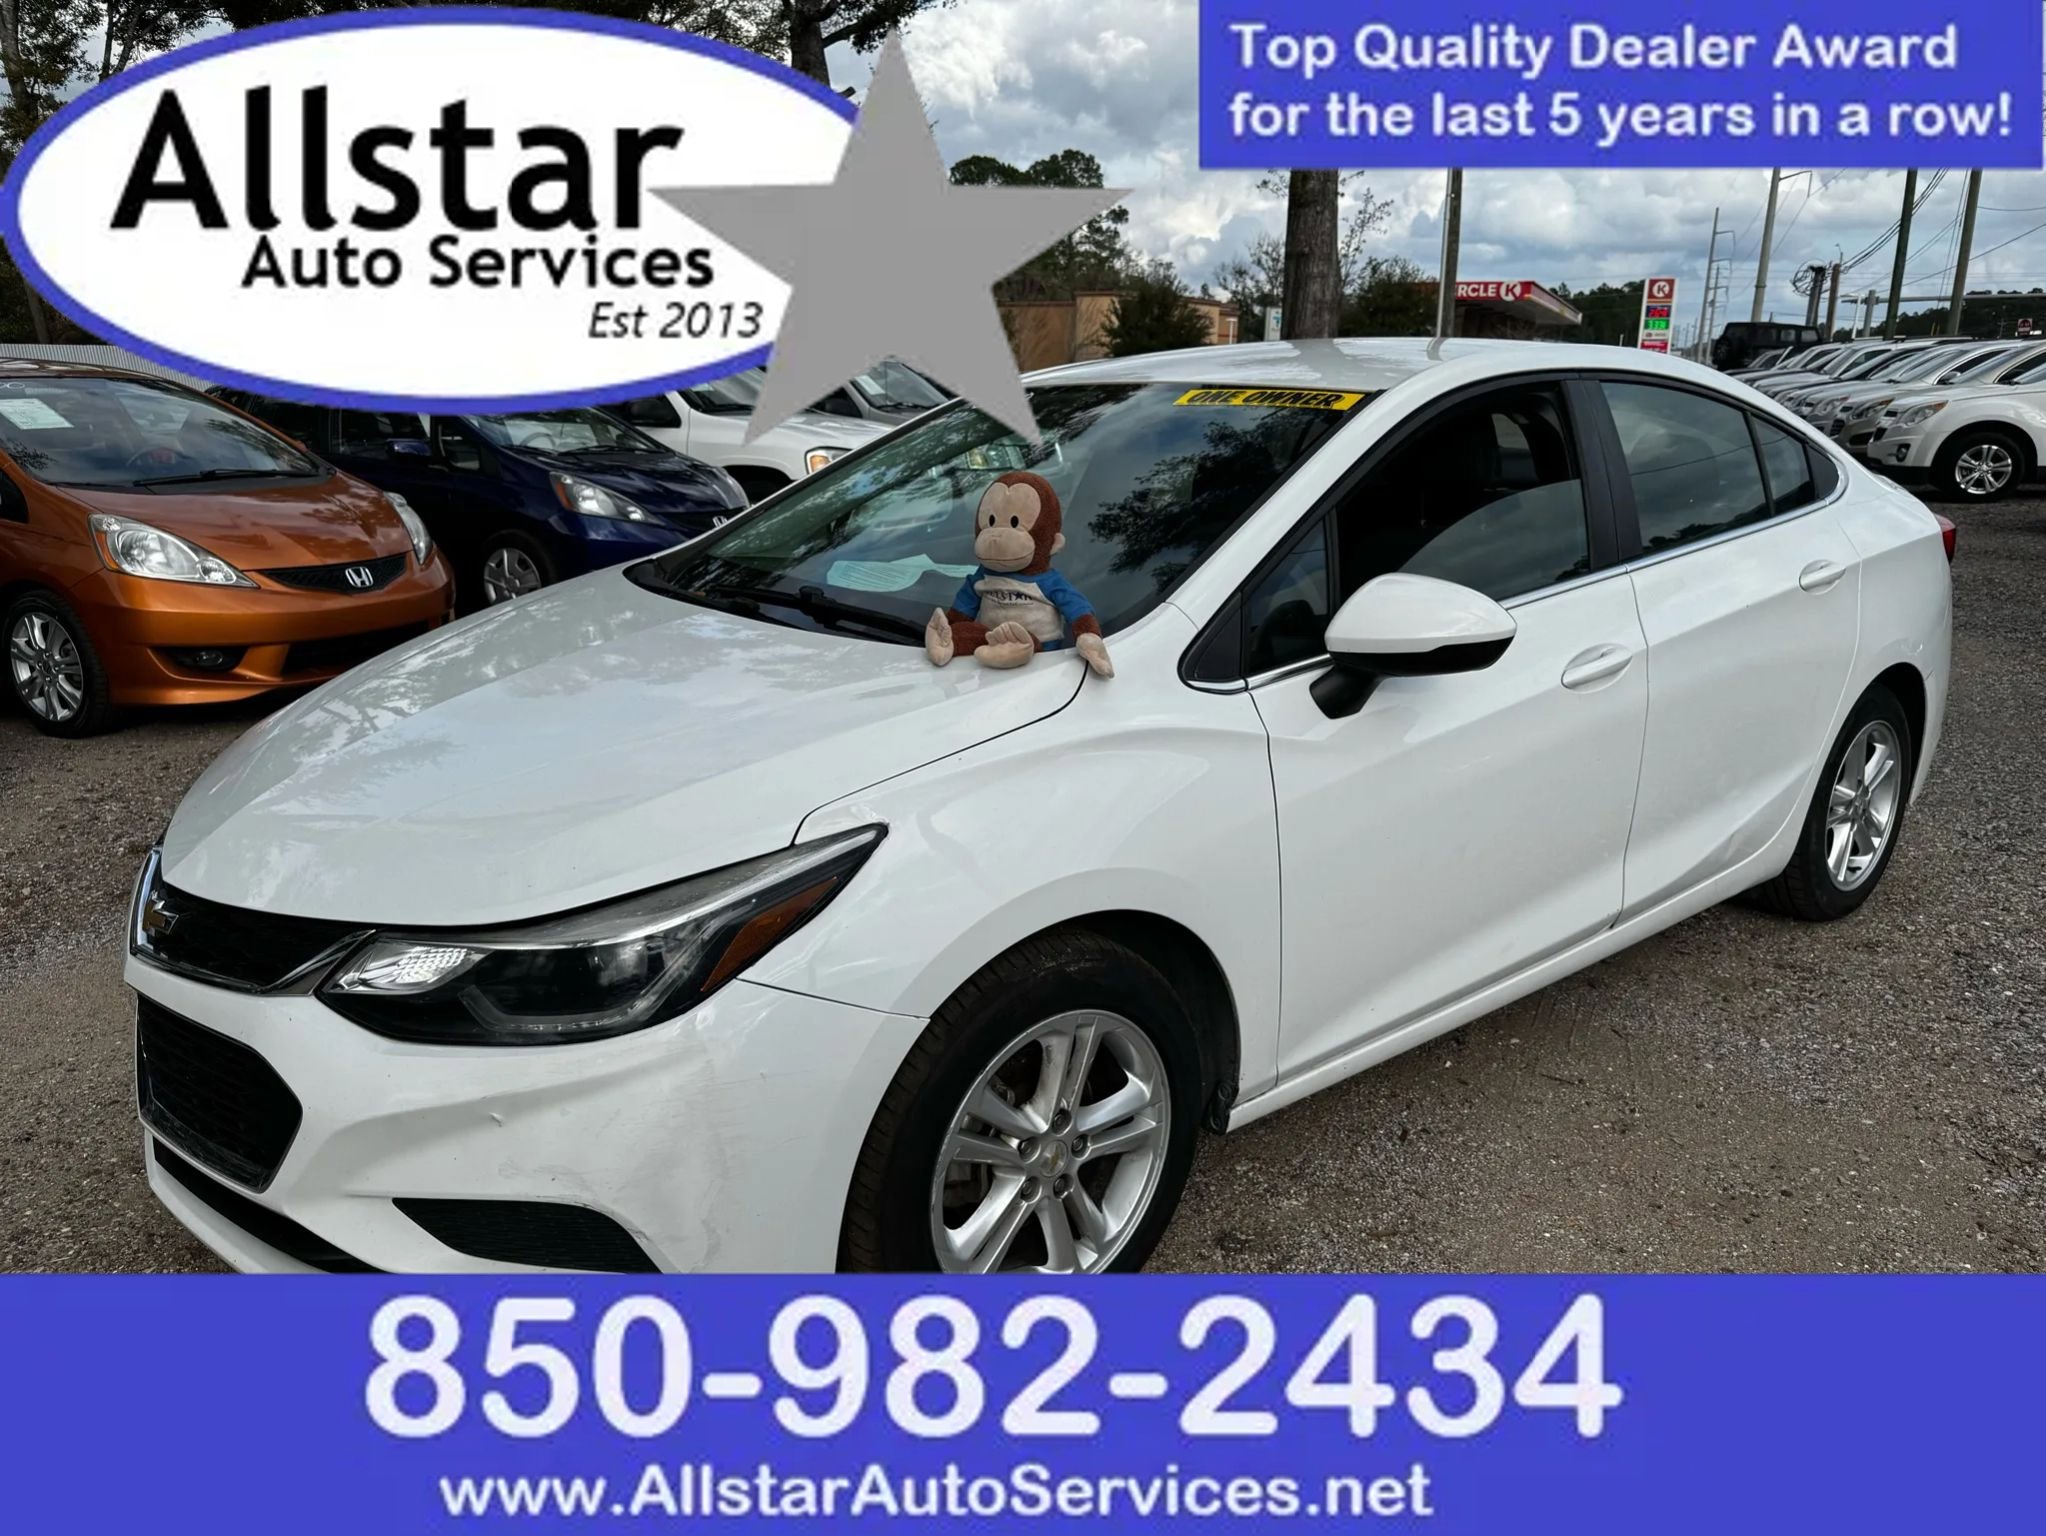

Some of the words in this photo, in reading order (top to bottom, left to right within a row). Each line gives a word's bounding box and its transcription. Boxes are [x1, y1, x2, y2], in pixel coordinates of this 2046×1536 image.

[1456, 283, 1497, 298] RCLE
[1503, 282, 1520, 300] K
[1187, 390, 1245, 405] ONE
[1243, 391, 1344, 407] OWNER
